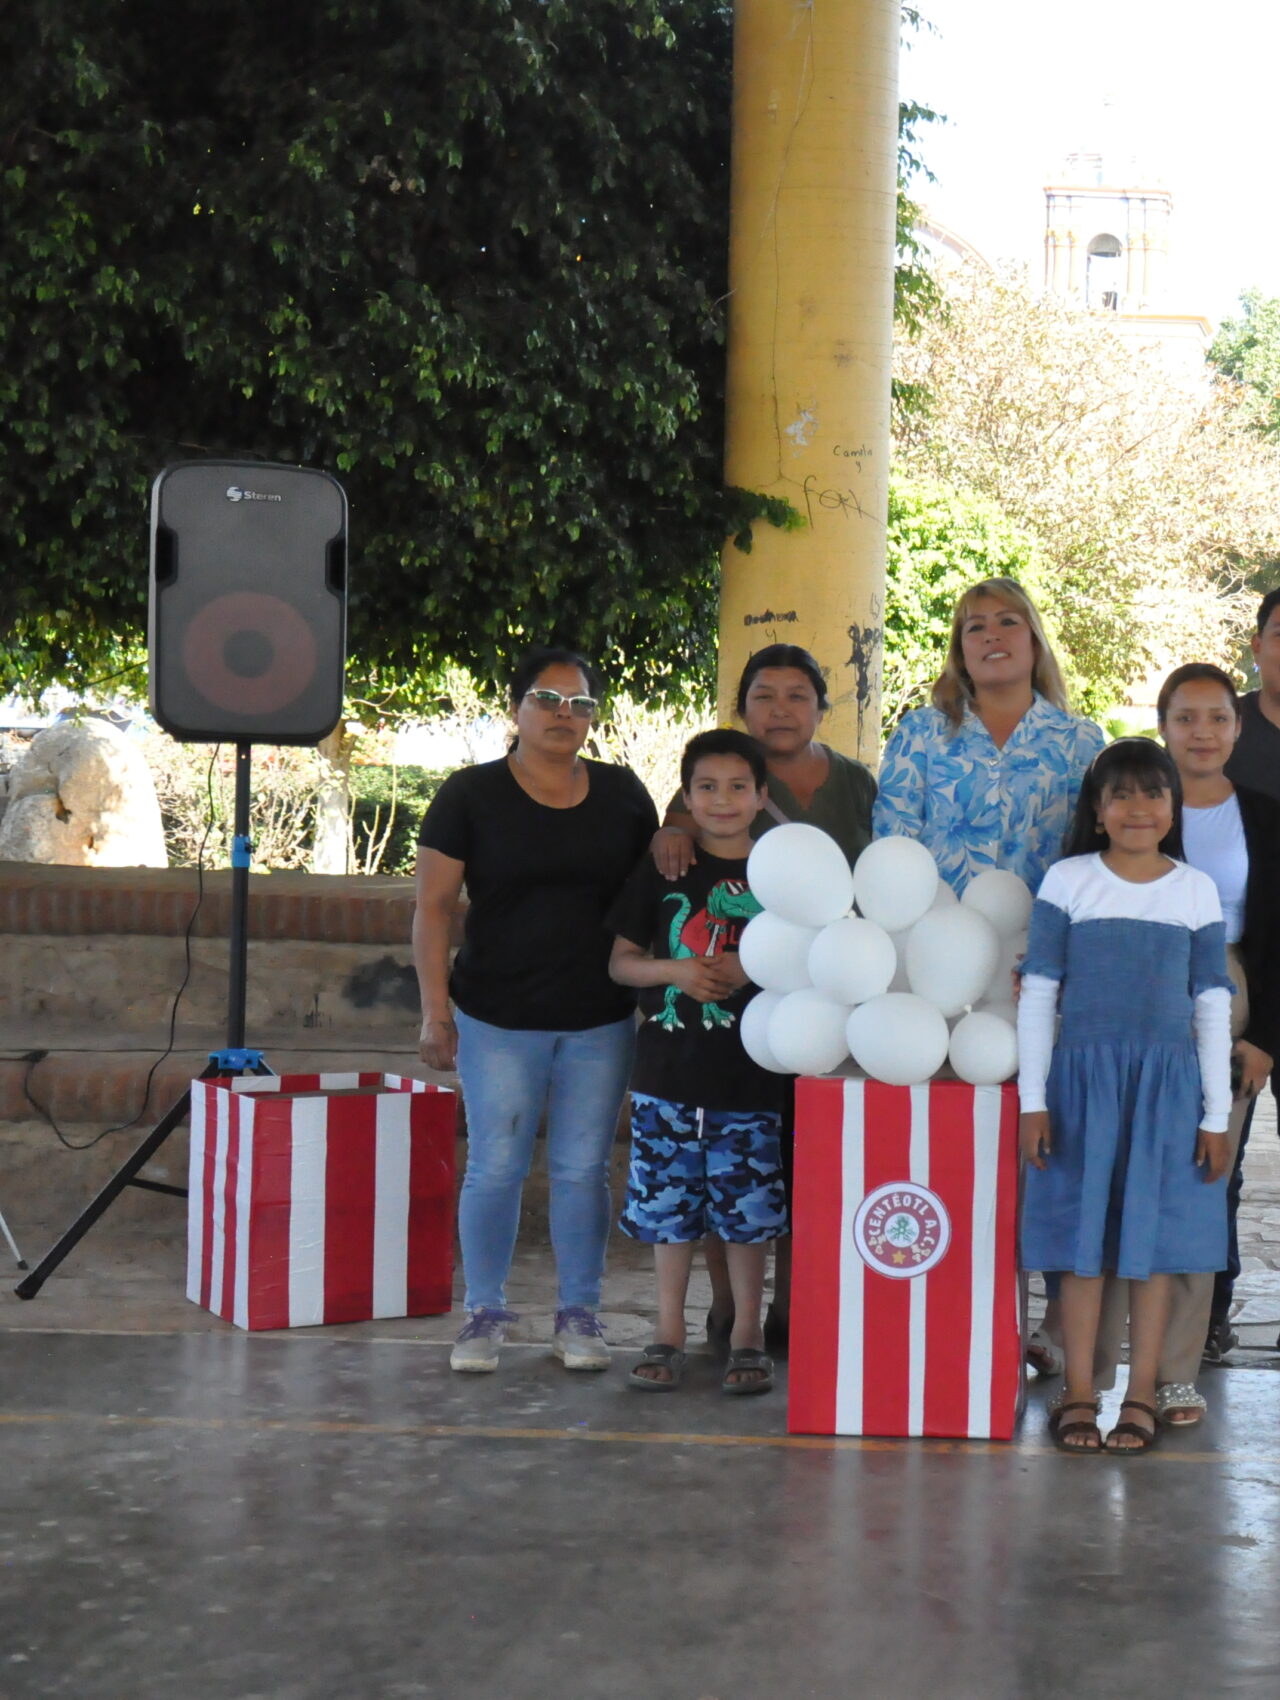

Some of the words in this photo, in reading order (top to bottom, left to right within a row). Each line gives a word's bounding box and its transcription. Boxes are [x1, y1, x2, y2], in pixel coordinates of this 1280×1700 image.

[243, 490, 282, 502] Steren
[868, 1193, 928, 1236] CENTÉOTL
[920, 1220, 938, 1246] A.C.
